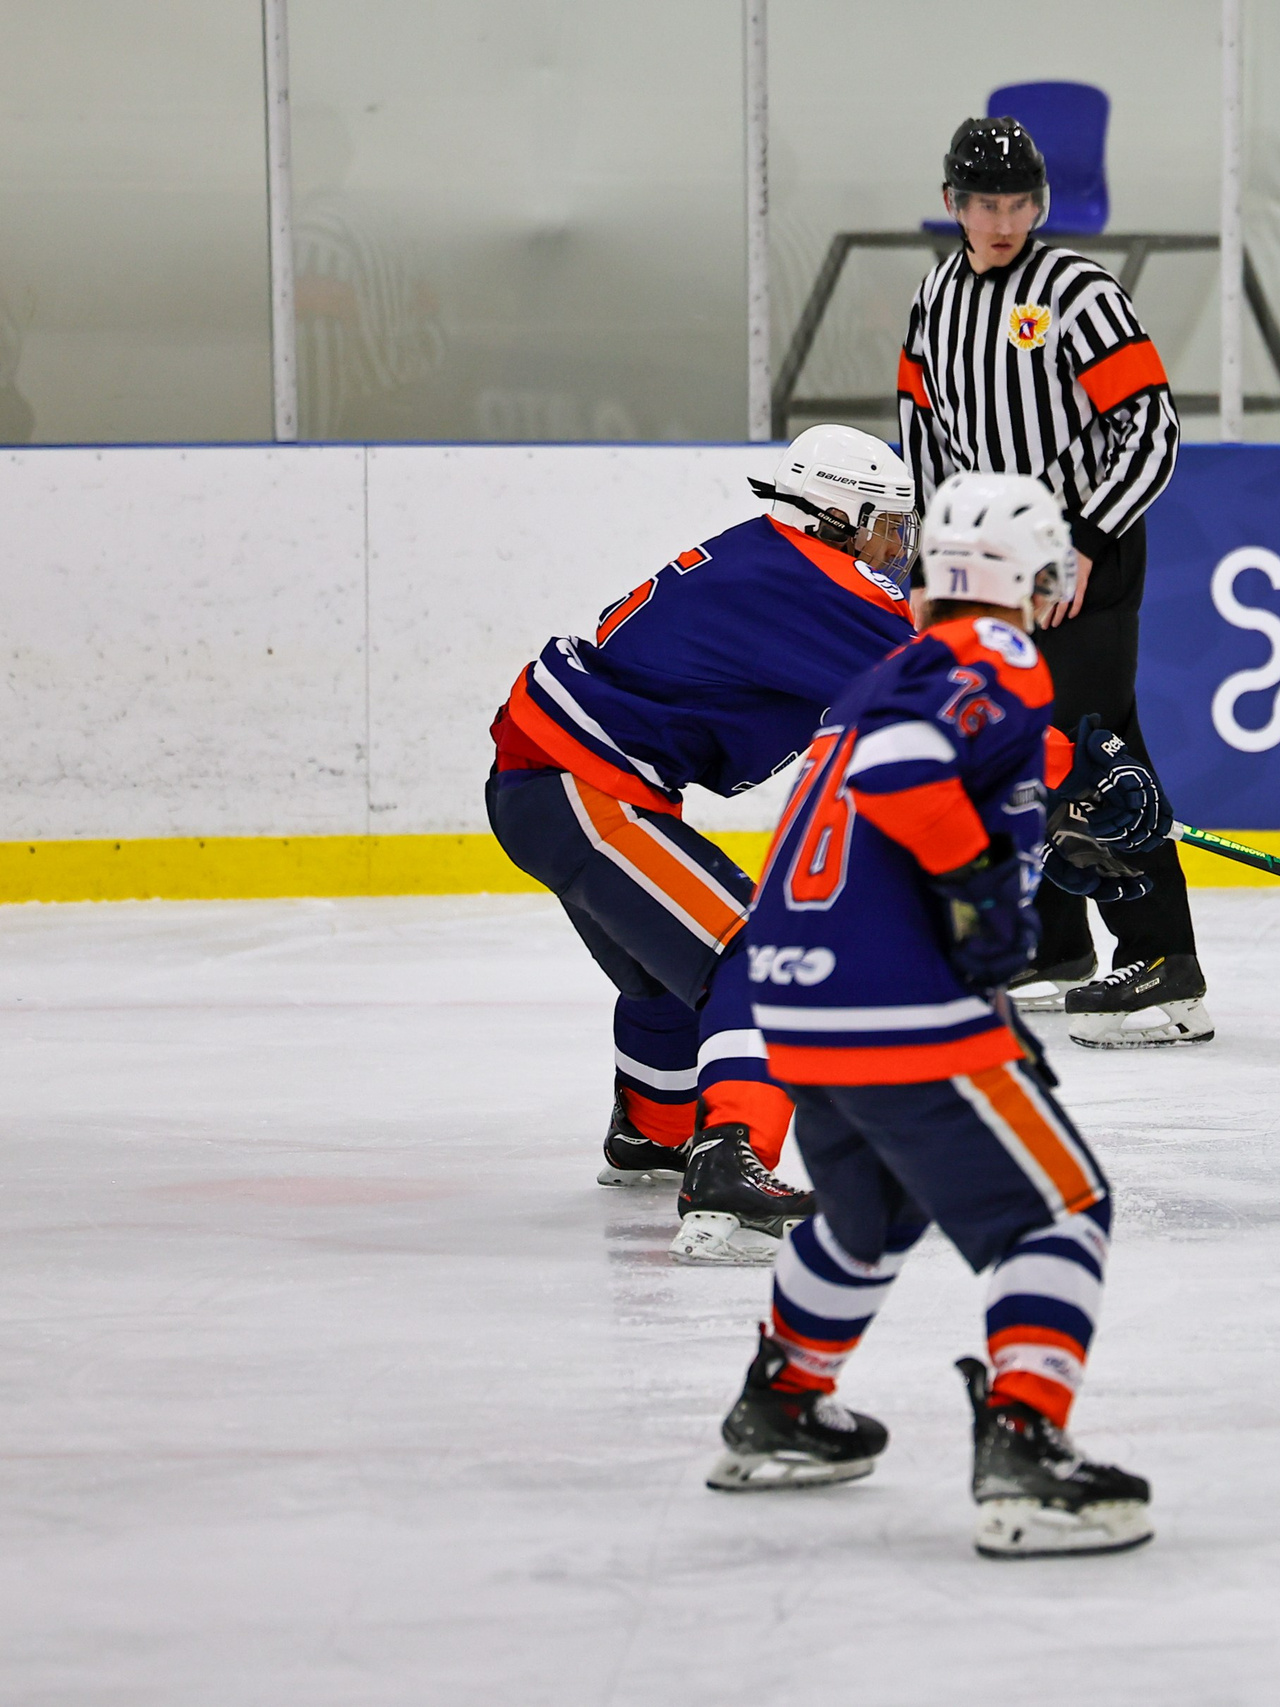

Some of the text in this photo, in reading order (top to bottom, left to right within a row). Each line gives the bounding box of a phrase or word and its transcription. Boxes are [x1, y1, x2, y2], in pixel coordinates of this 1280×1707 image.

[995, 136, 1010, 155] 7
[816, 471, 858, 486] BAUER
[817, 511, 846, 529] BAUER
[949, 566, 968, 592] 71
[938, 665, 1005, 739] 76
[1183, 824, 1266, 858] UPERNOVA
